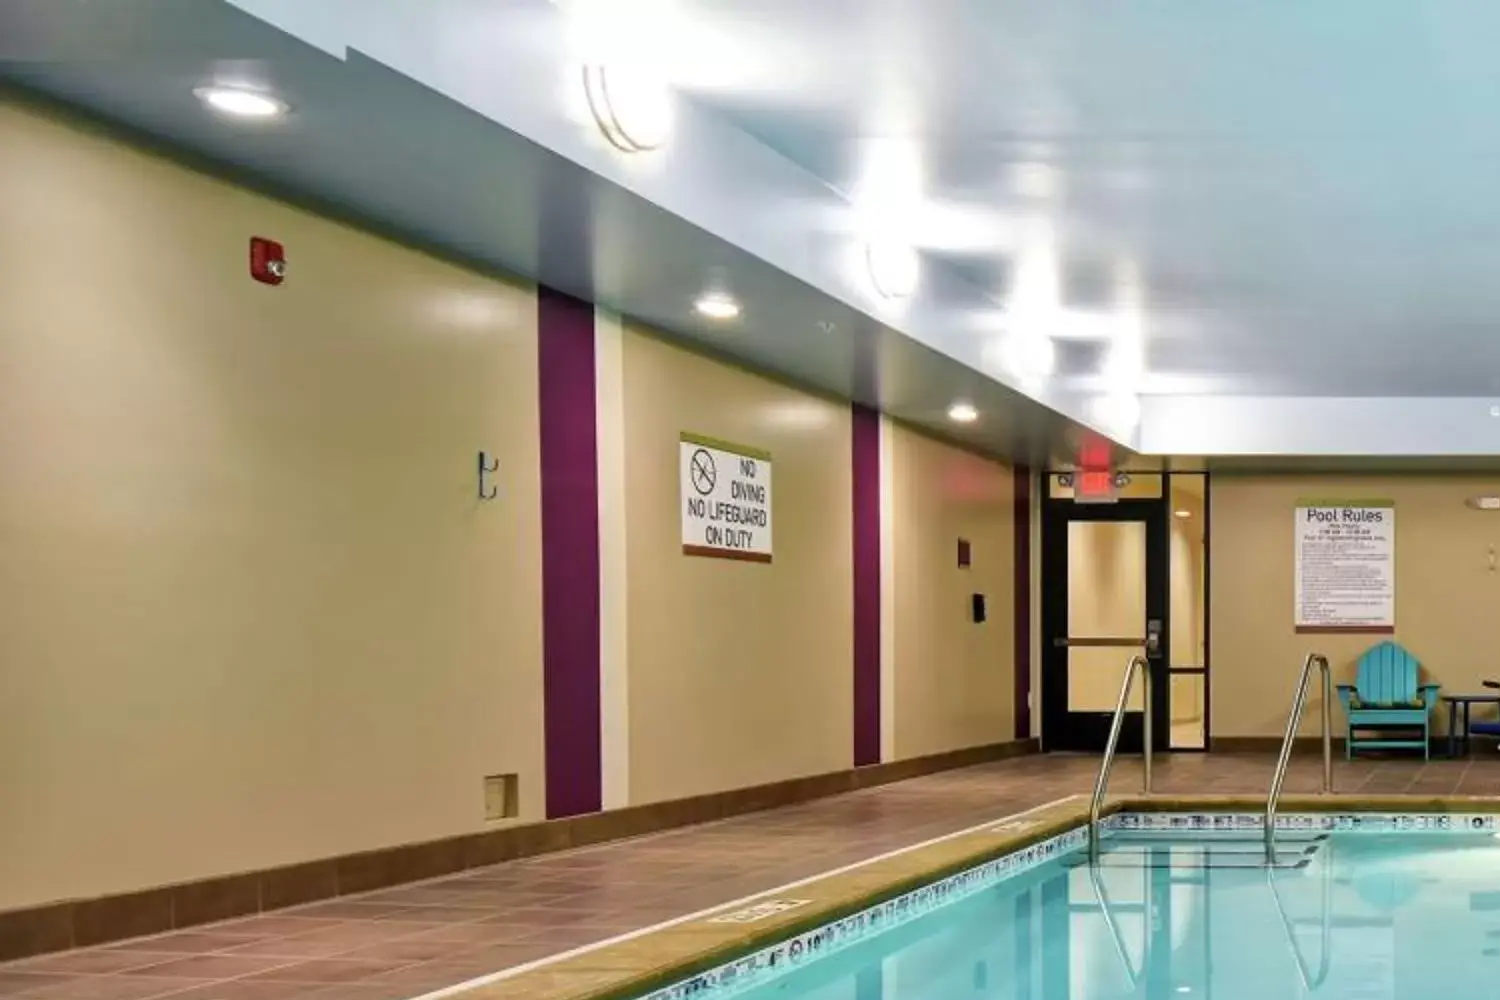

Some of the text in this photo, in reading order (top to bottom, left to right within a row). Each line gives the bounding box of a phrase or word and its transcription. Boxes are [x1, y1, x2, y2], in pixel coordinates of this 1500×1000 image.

[740, 458, 756, 478] NO
[731, 480, 765, 504] DIVING
[688, 498, 767, 527] NO LIFEGUARD
[1307, 509, 1383, 522] Pool Rules
[705, 525, 753, 548] ON DUTY
